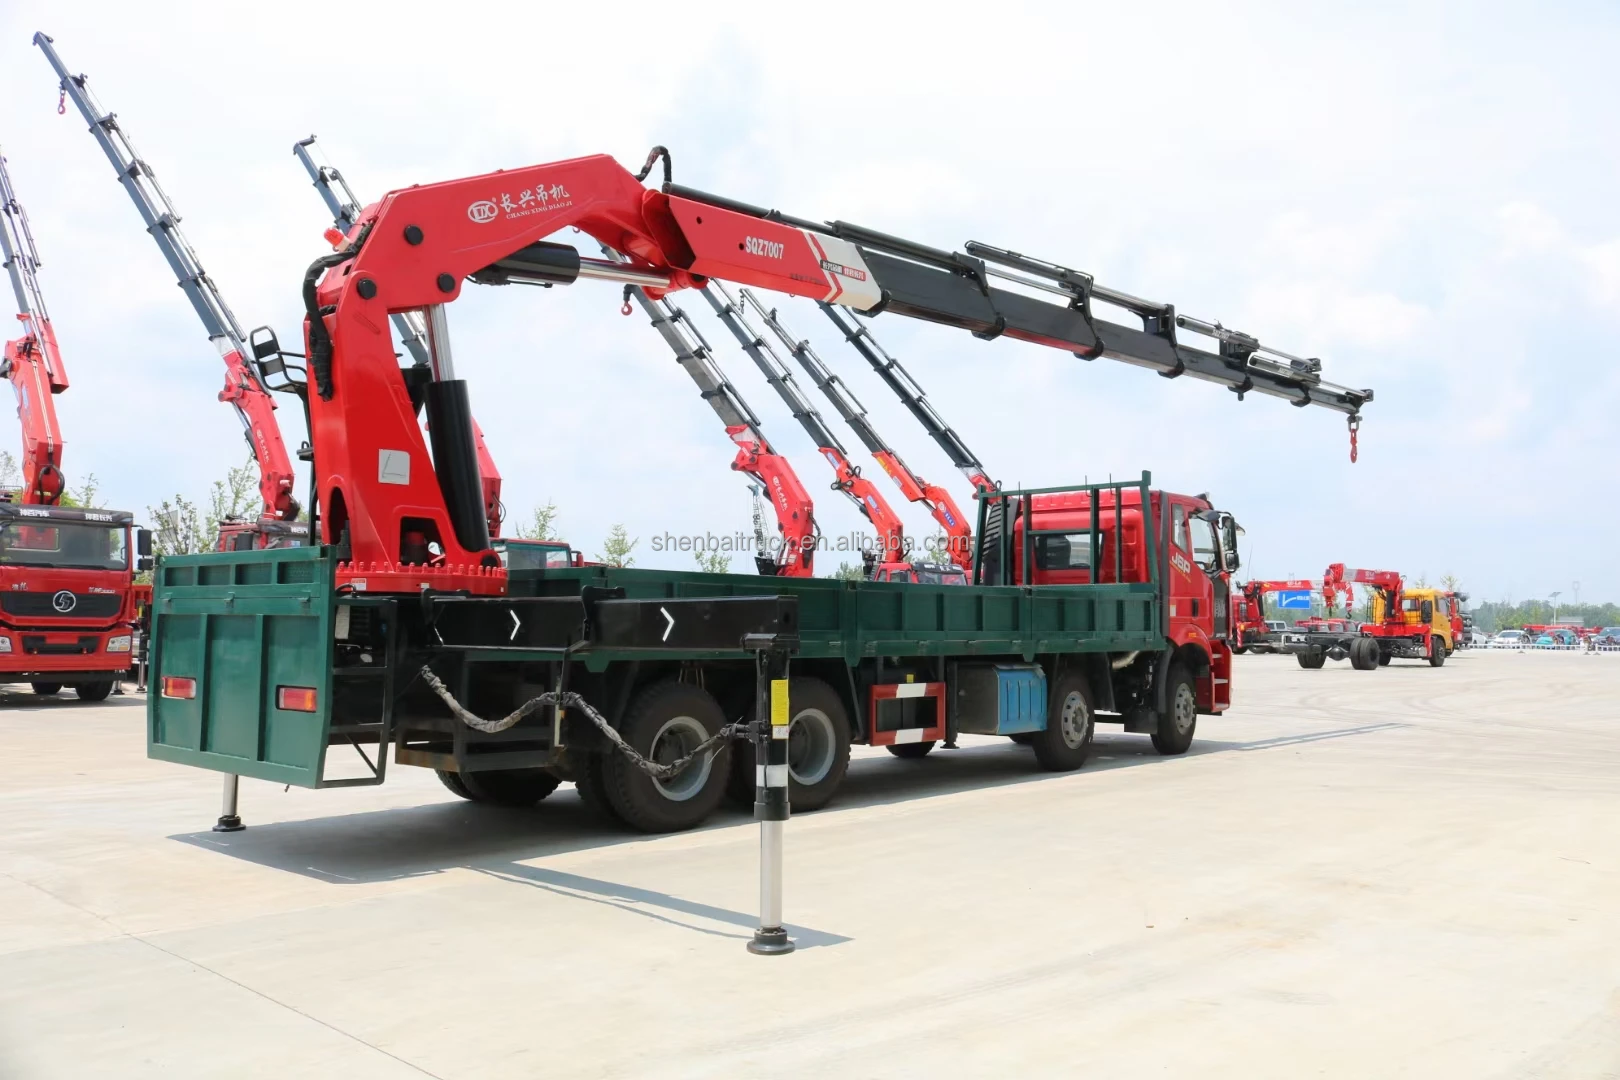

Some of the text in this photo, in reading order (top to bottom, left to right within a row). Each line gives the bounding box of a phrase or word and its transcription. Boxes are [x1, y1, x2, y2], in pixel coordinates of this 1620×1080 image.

[500, 184, 570, 213] 长兴吊机
[506, 210, 530, 219] CHANG
[531, 206, 548, 214] XING
[549, 202, 566, 211] DIAO
[745, 236, 785, 260] SQZ7007
